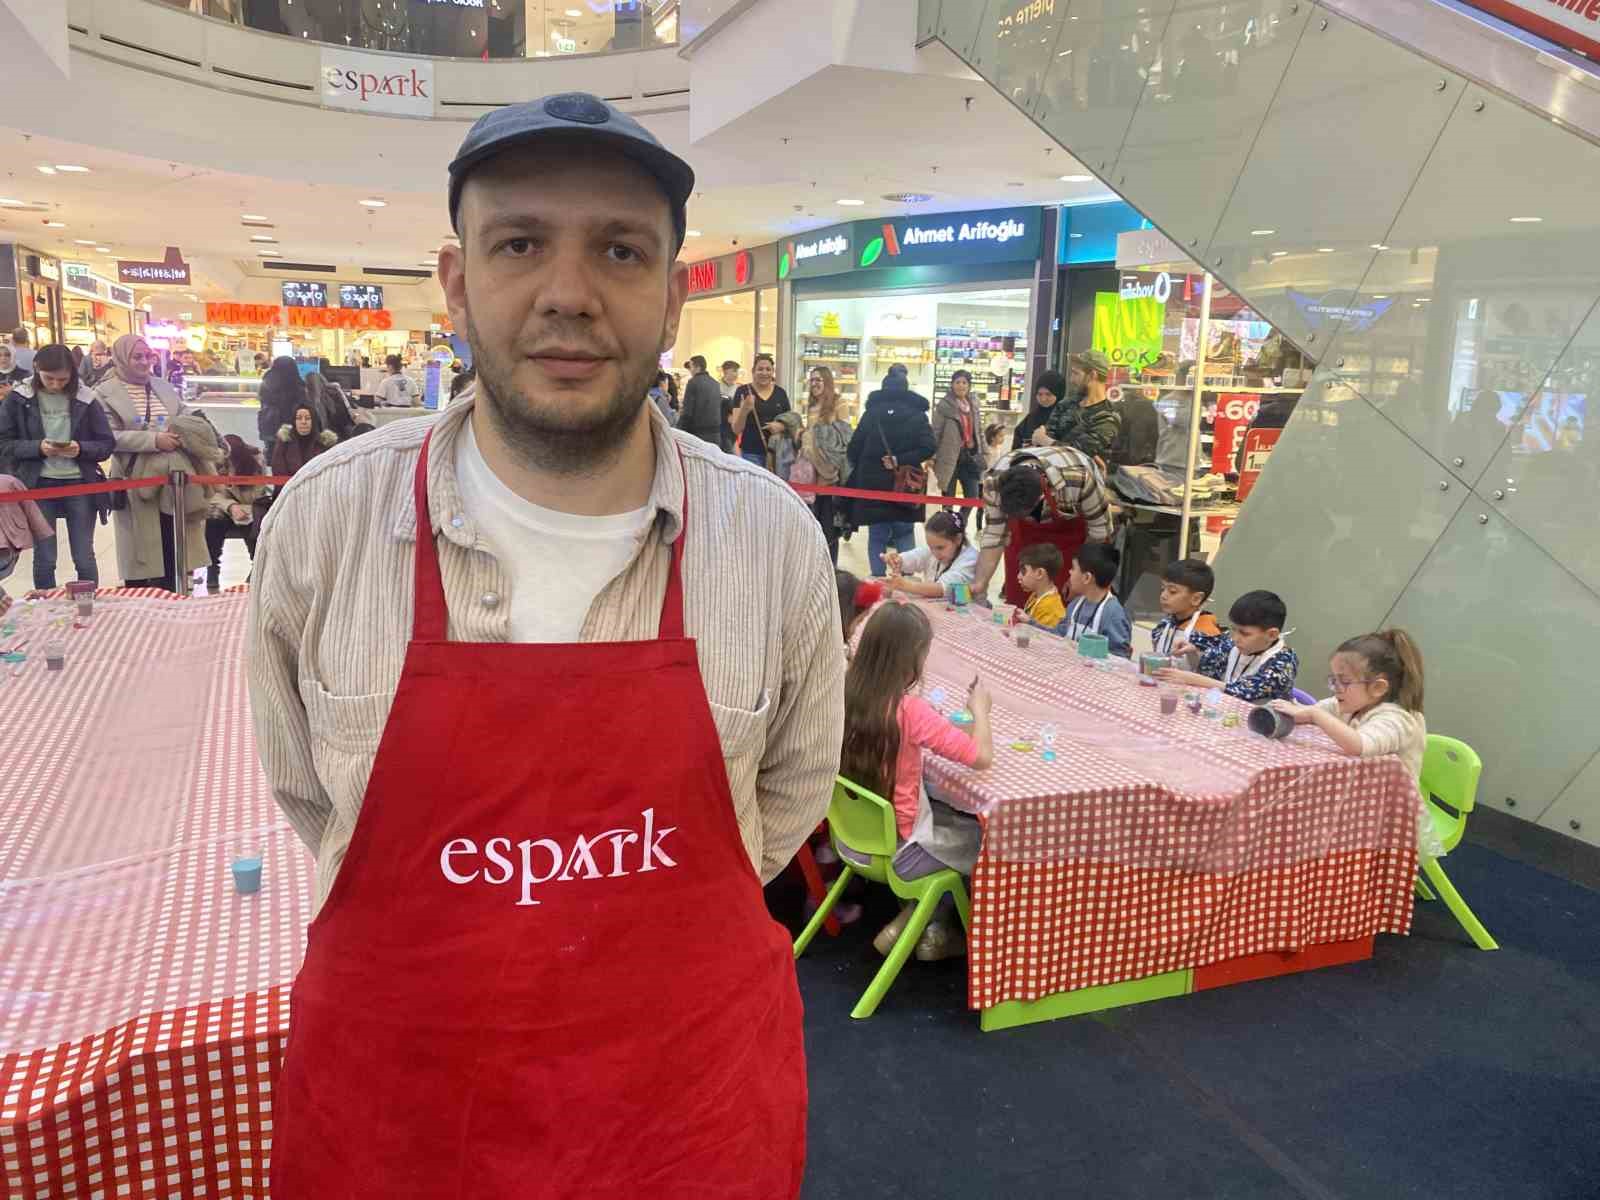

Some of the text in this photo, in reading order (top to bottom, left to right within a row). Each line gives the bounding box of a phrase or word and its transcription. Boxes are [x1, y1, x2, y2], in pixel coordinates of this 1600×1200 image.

[324, 67, 429, 102] espark
[903, 219, 1025, 246] Ahmet Arifoğlu
[439, 807, 679, 906] espark
